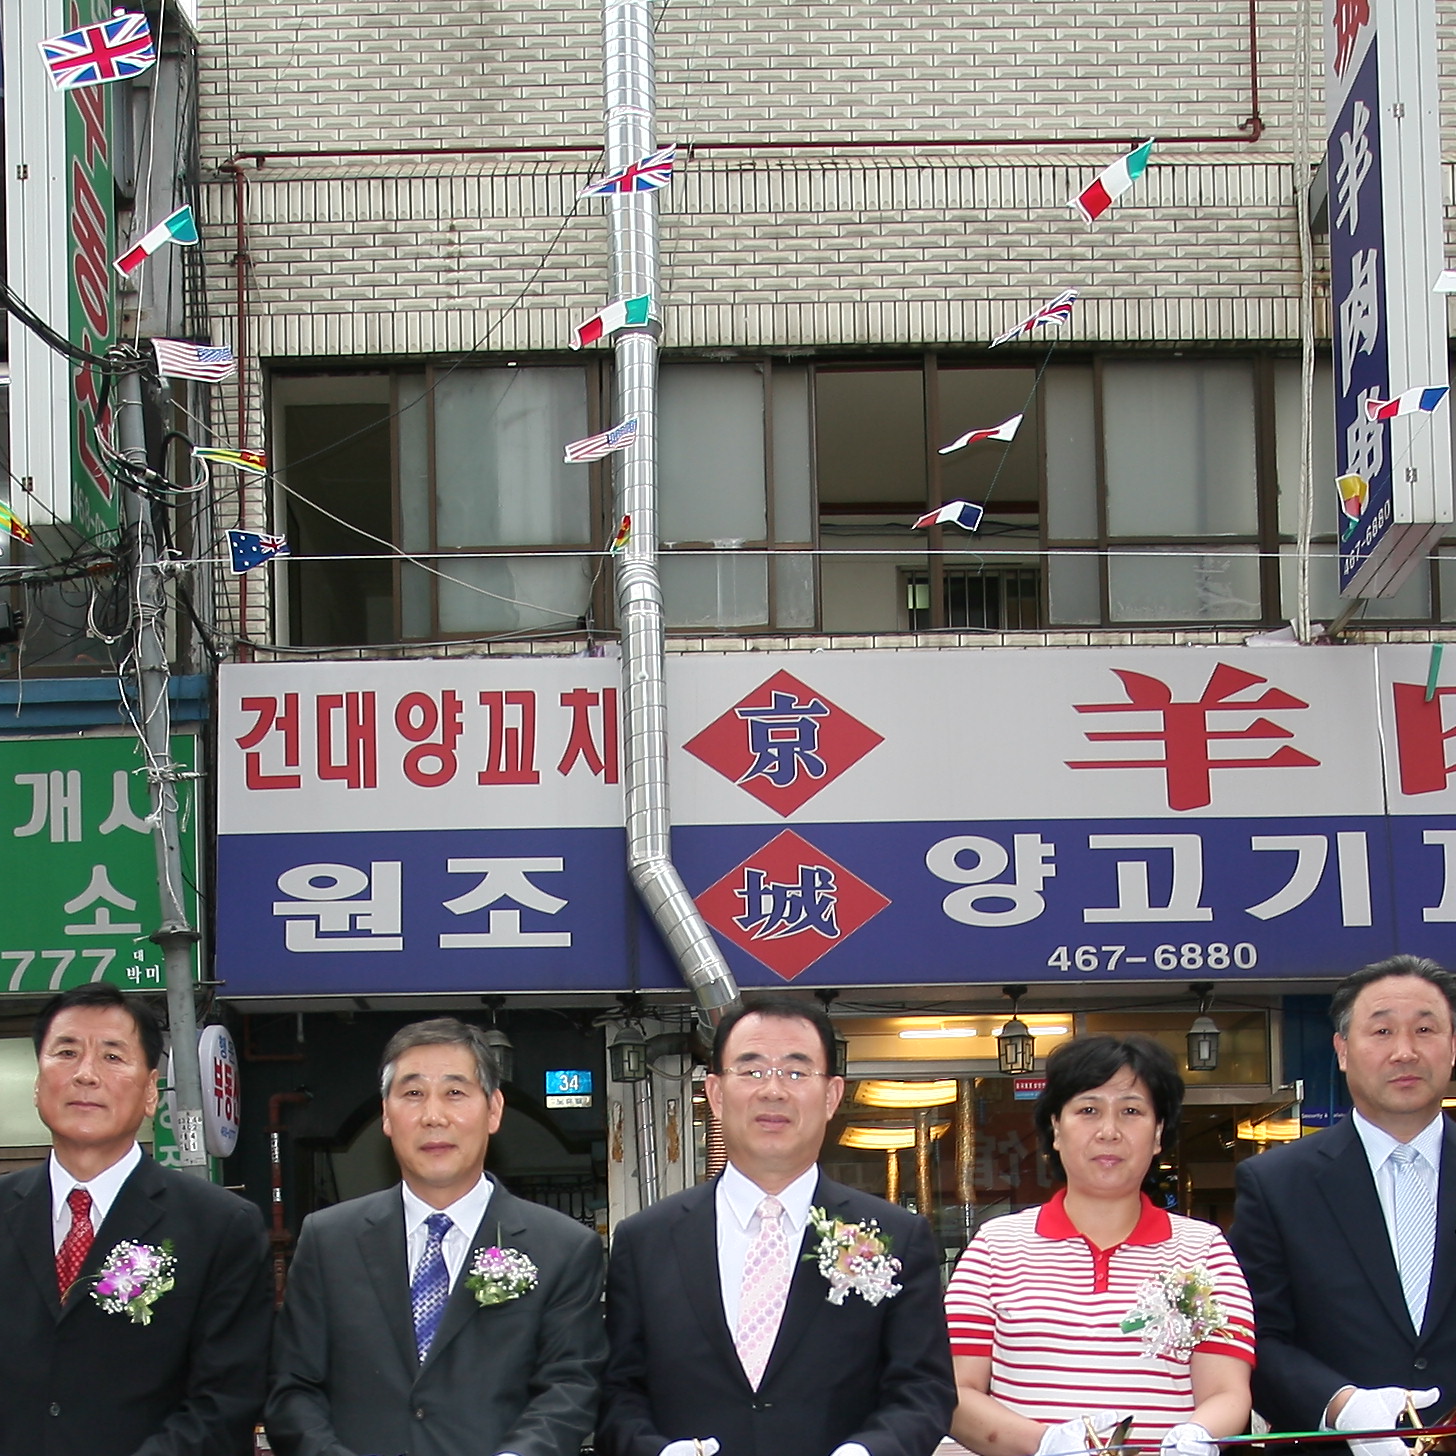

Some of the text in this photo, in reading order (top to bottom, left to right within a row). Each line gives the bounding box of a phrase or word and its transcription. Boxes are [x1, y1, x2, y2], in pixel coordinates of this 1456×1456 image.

[1343, 499, 1392, 577] 467-6880
[235, 687, 619, 791] 건대양꼬치
[272, 856, 572, 953] 원조
[1047, 942, 1259, 972] 467-6880
[559, 1074, 579, 1091] 34
